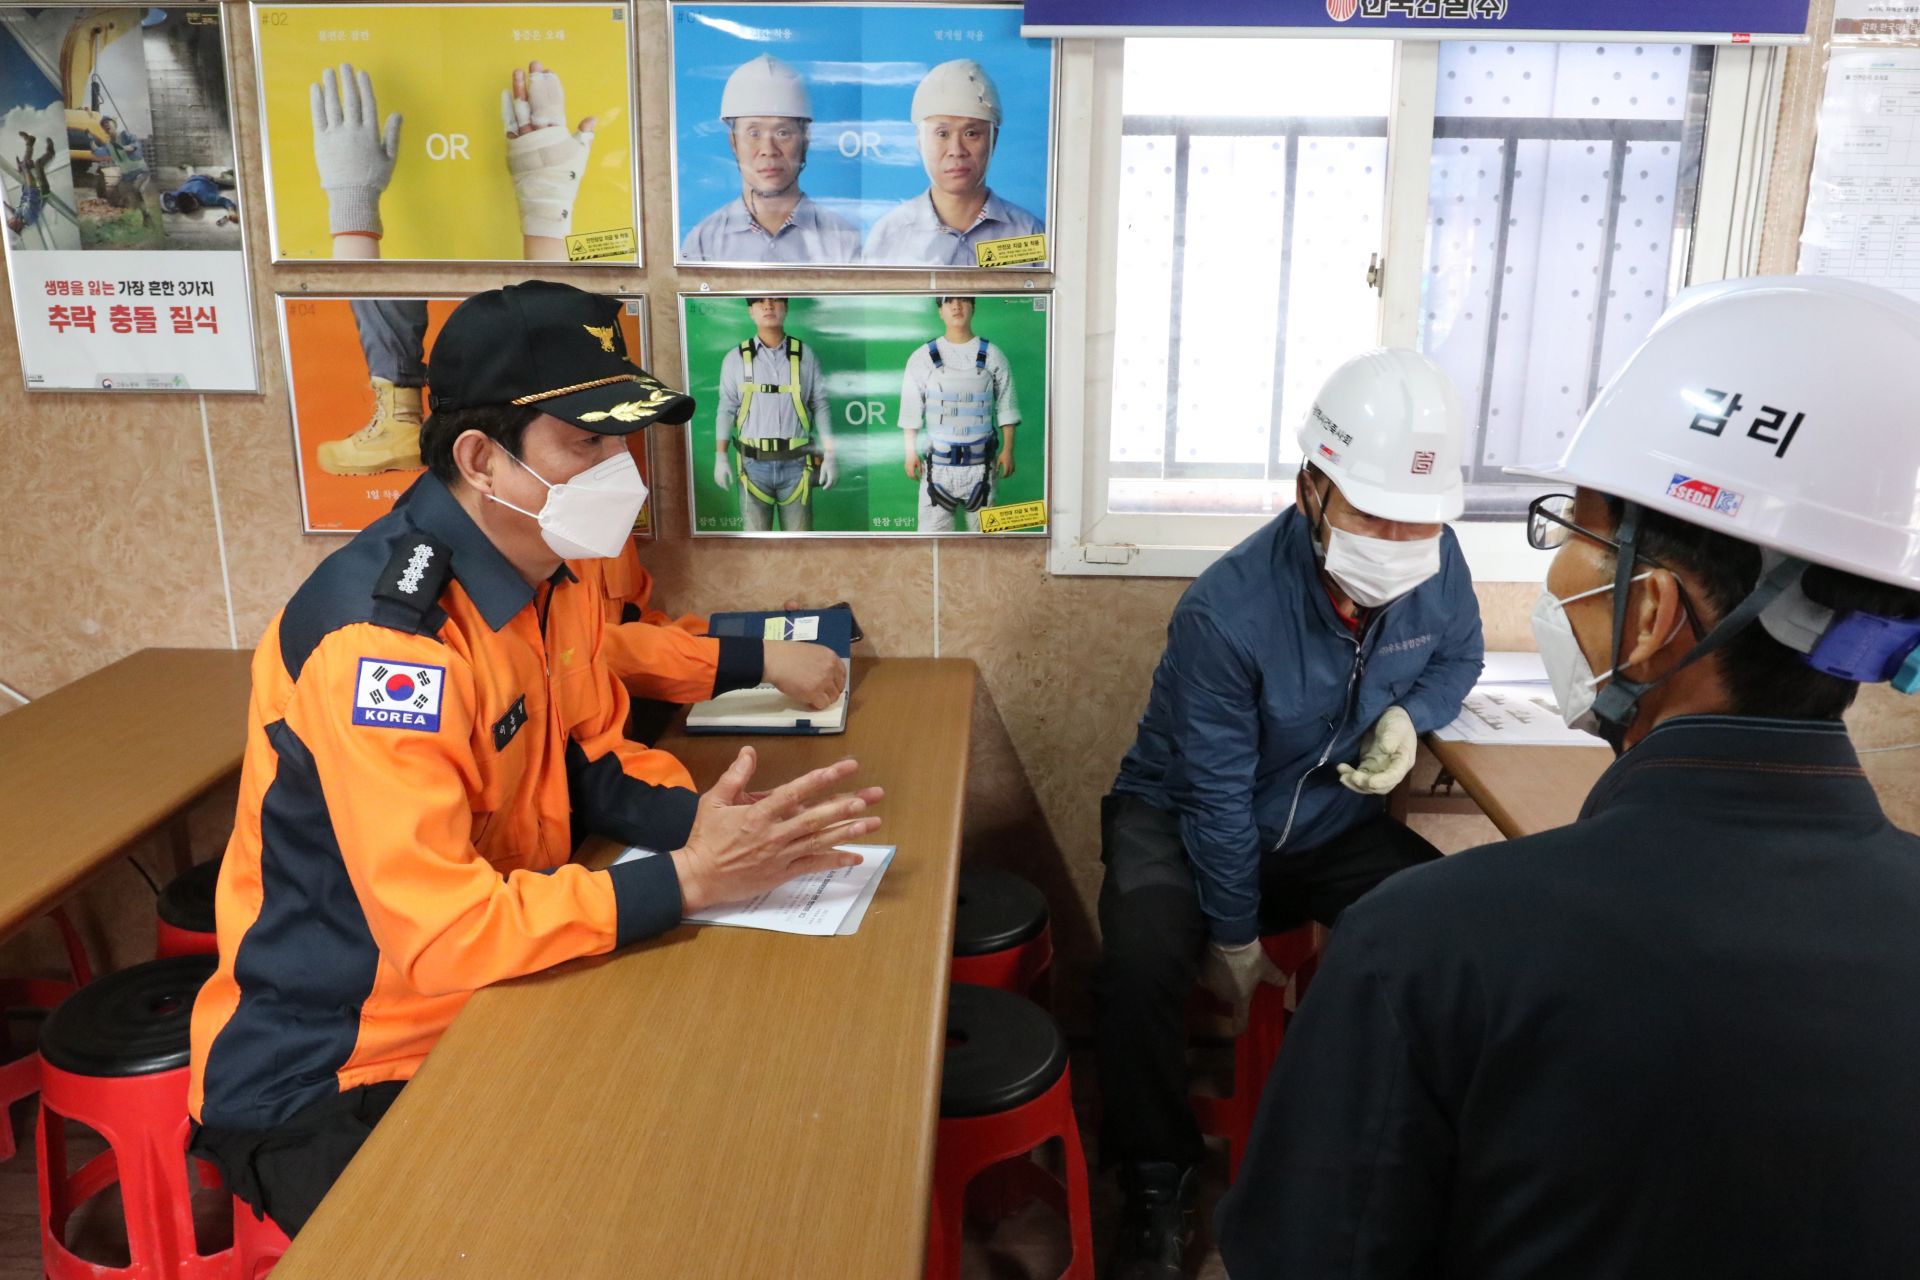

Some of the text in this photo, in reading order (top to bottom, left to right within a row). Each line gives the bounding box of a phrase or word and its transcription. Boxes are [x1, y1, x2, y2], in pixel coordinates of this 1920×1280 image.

[426, 133, 470, 160] OR
[839, 131, 882, 158] OR
[44, 280, 214, 296] 생명을 잃는 가장 흔한 3가지
[48, 304, 218, 334] 추락 충돌 질식
[845, 400, 887, 425] OR
[365, 710, 427, 725] KOREA
